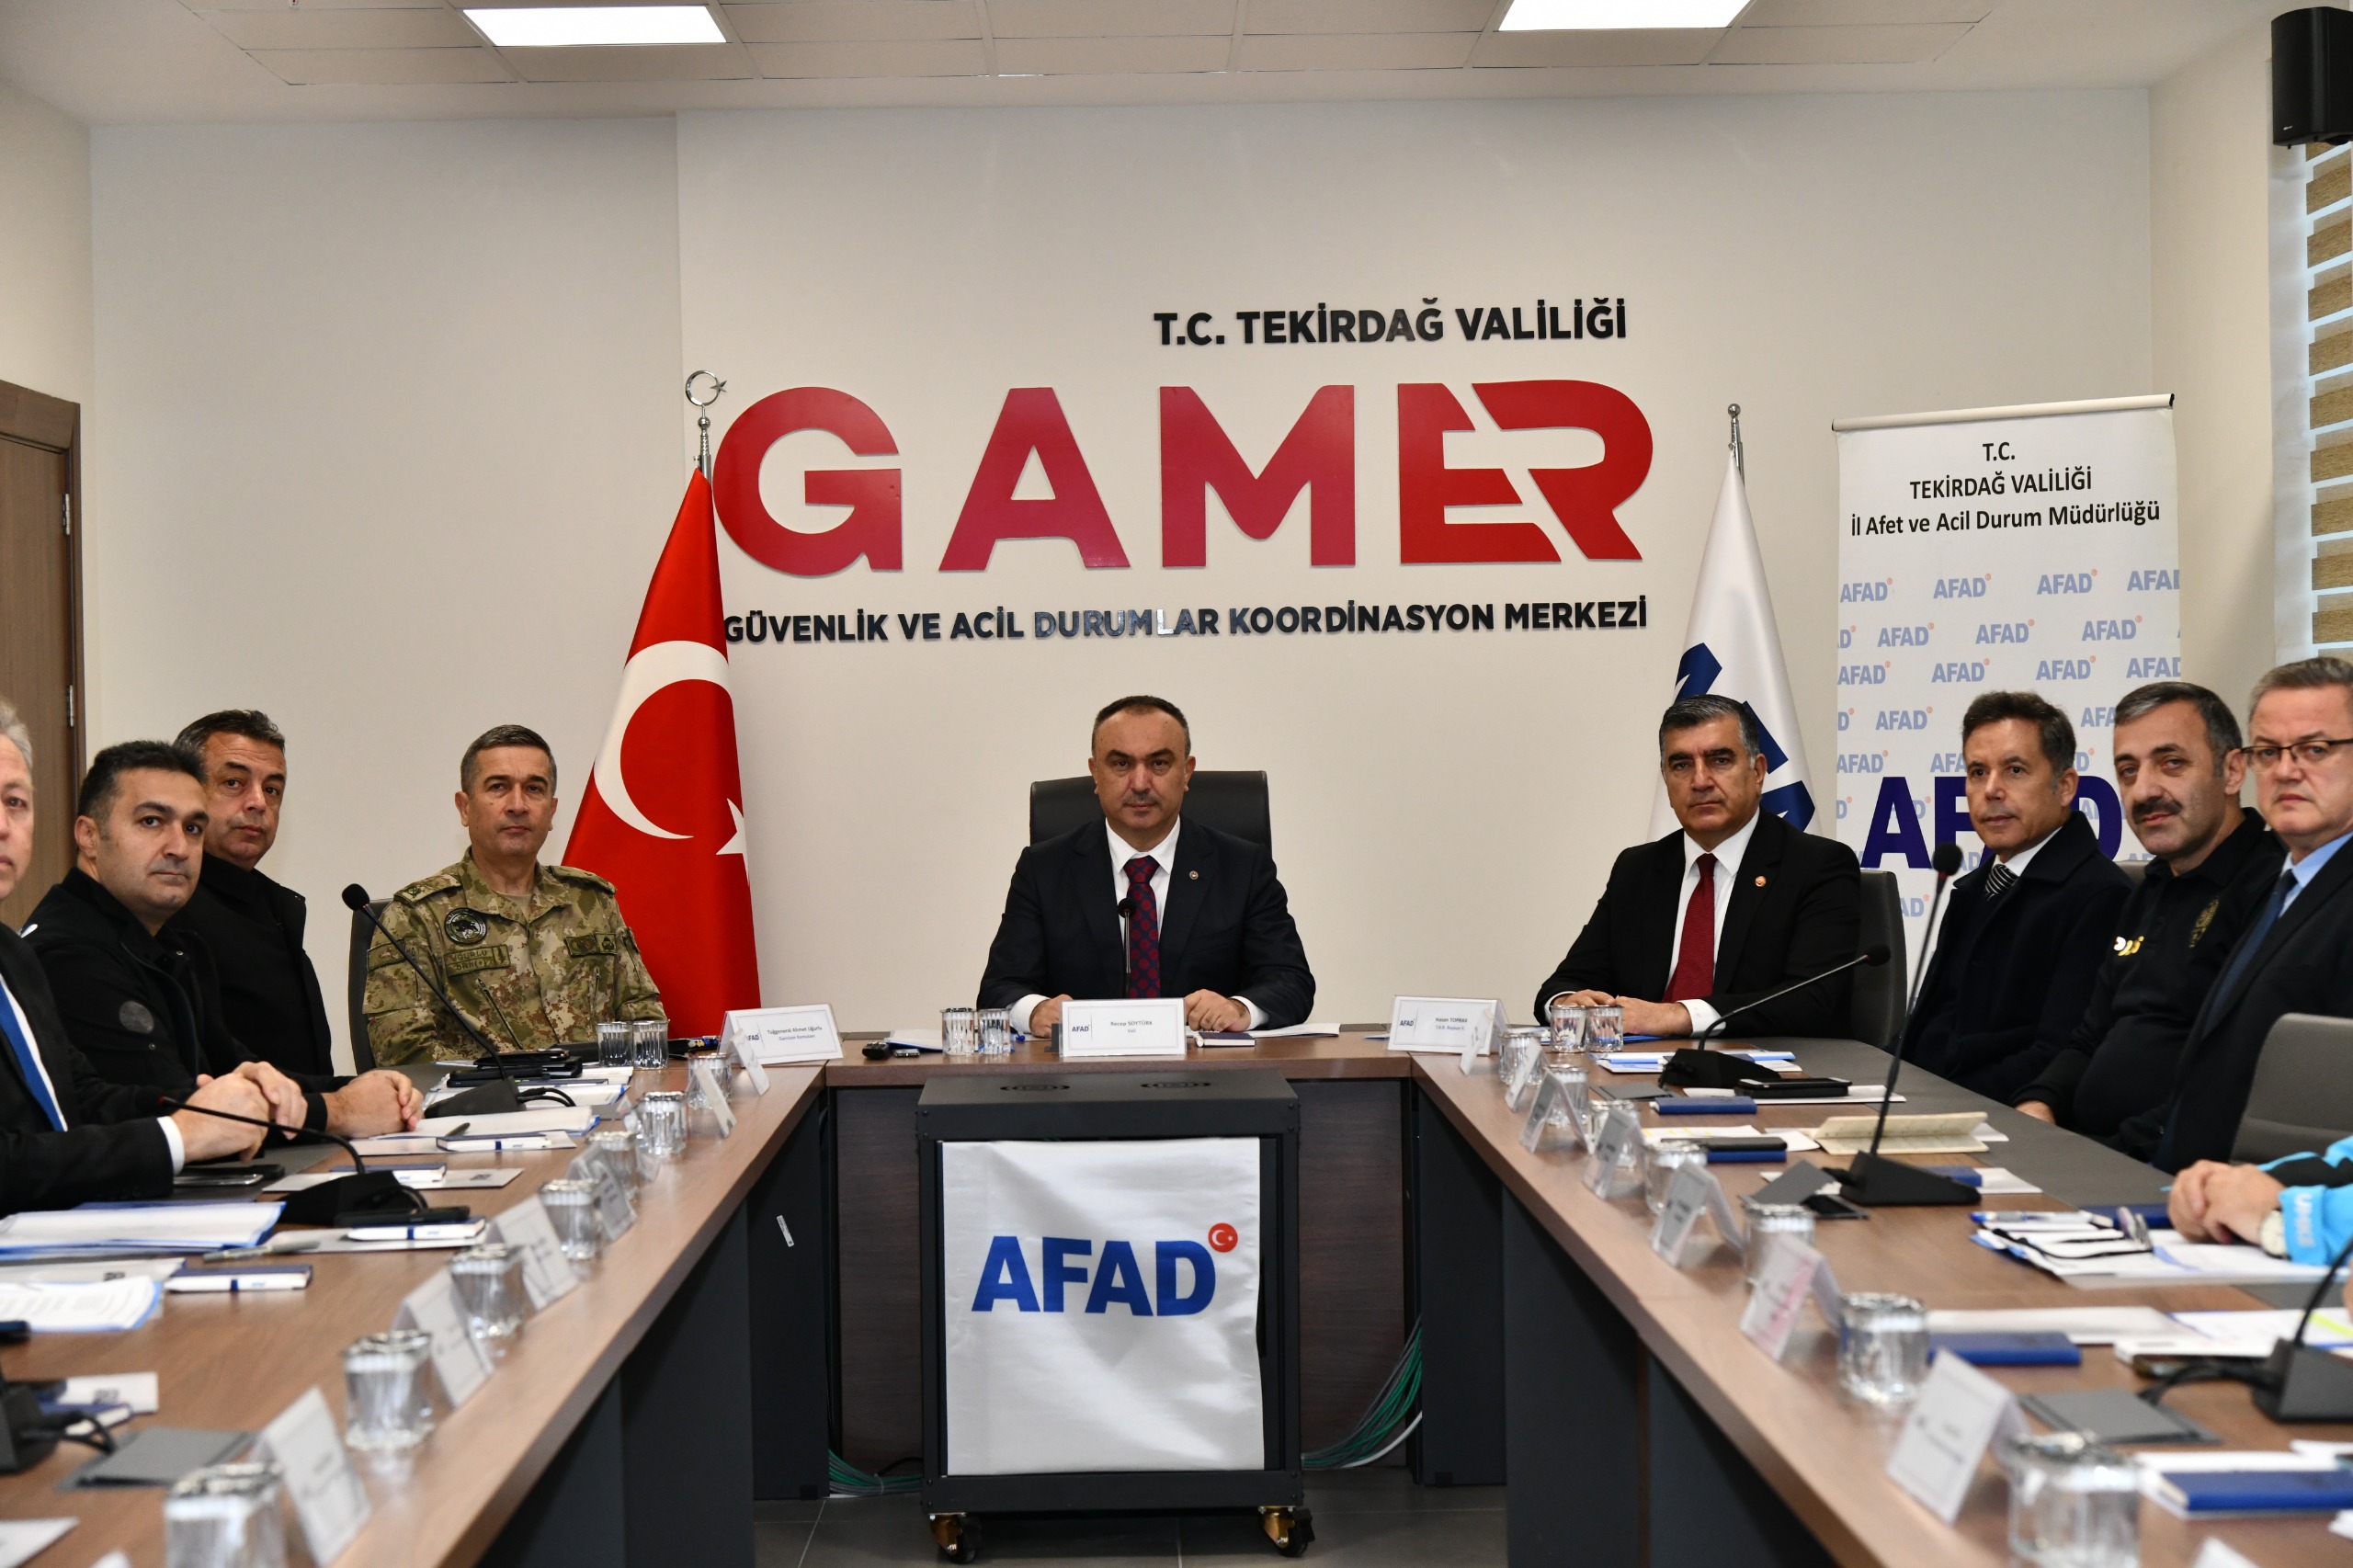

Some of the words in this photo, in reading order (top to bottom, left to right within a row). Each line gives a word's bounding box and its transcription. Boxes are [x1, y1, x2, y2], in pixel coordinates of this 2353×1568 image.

[1154, 312, 1225, 346] T.C.
[1236, 297, 1444, 345] TEKİRDAĞ
[1455, 297, 1627, 340] VALİLİĞİ
[1983, 442, 2016, 460] T.C.
[712, 380, 1654, 576] GAMER
[1910, 470, 2006, 499] TEKİRDAĞ
[2011, 466, 2092, 494] VALİLİĞİ
[1851, 515, 1860, 536] İl
[1866, 515, 1904, 535] Afet
[1909, 518, 1930, 532] ve
[1937, 511, 1970, 531] Acil
[1977, 509, 2041, 529] Durum
[2049, 501, 2160, 527] Müdürlüğü
[1840, 582, 1888, 603] AFAD
[1933, 577, 1986, 598] AFAD
[2037, 574, 2092, 595] AFAD
[724, 608, 889, 642] GÜVENLİK
[898, 612, 941, 640] VE
[950, 606, 1025, 640] ACİL
[1035, 608, 1220, 640] DURUMLAR
[1229, 599, 1495, 635] KOORDİNASYON
[1505, 595, 1647, 629] MERKEZİ
[1877, 626, 1928, 647] AFAD
[1975, 622, 2029, 643] AFAD
[2081, 619, 2136, 641] AFAD
[1838, 665, 1886, 685] AFAD
[1931, 662, 1984, 683] AFAD
[2036, 659, 2091, 680] AFAD
[1876, 710, 1927, 731] AFAD
[2081, 707, 2116, 727] AFA
[1837, 754, 1883, 774] AFAD
[1930, 753, 1966, 773] AFA
[972, 1235, 1216, 1316] AFAD
